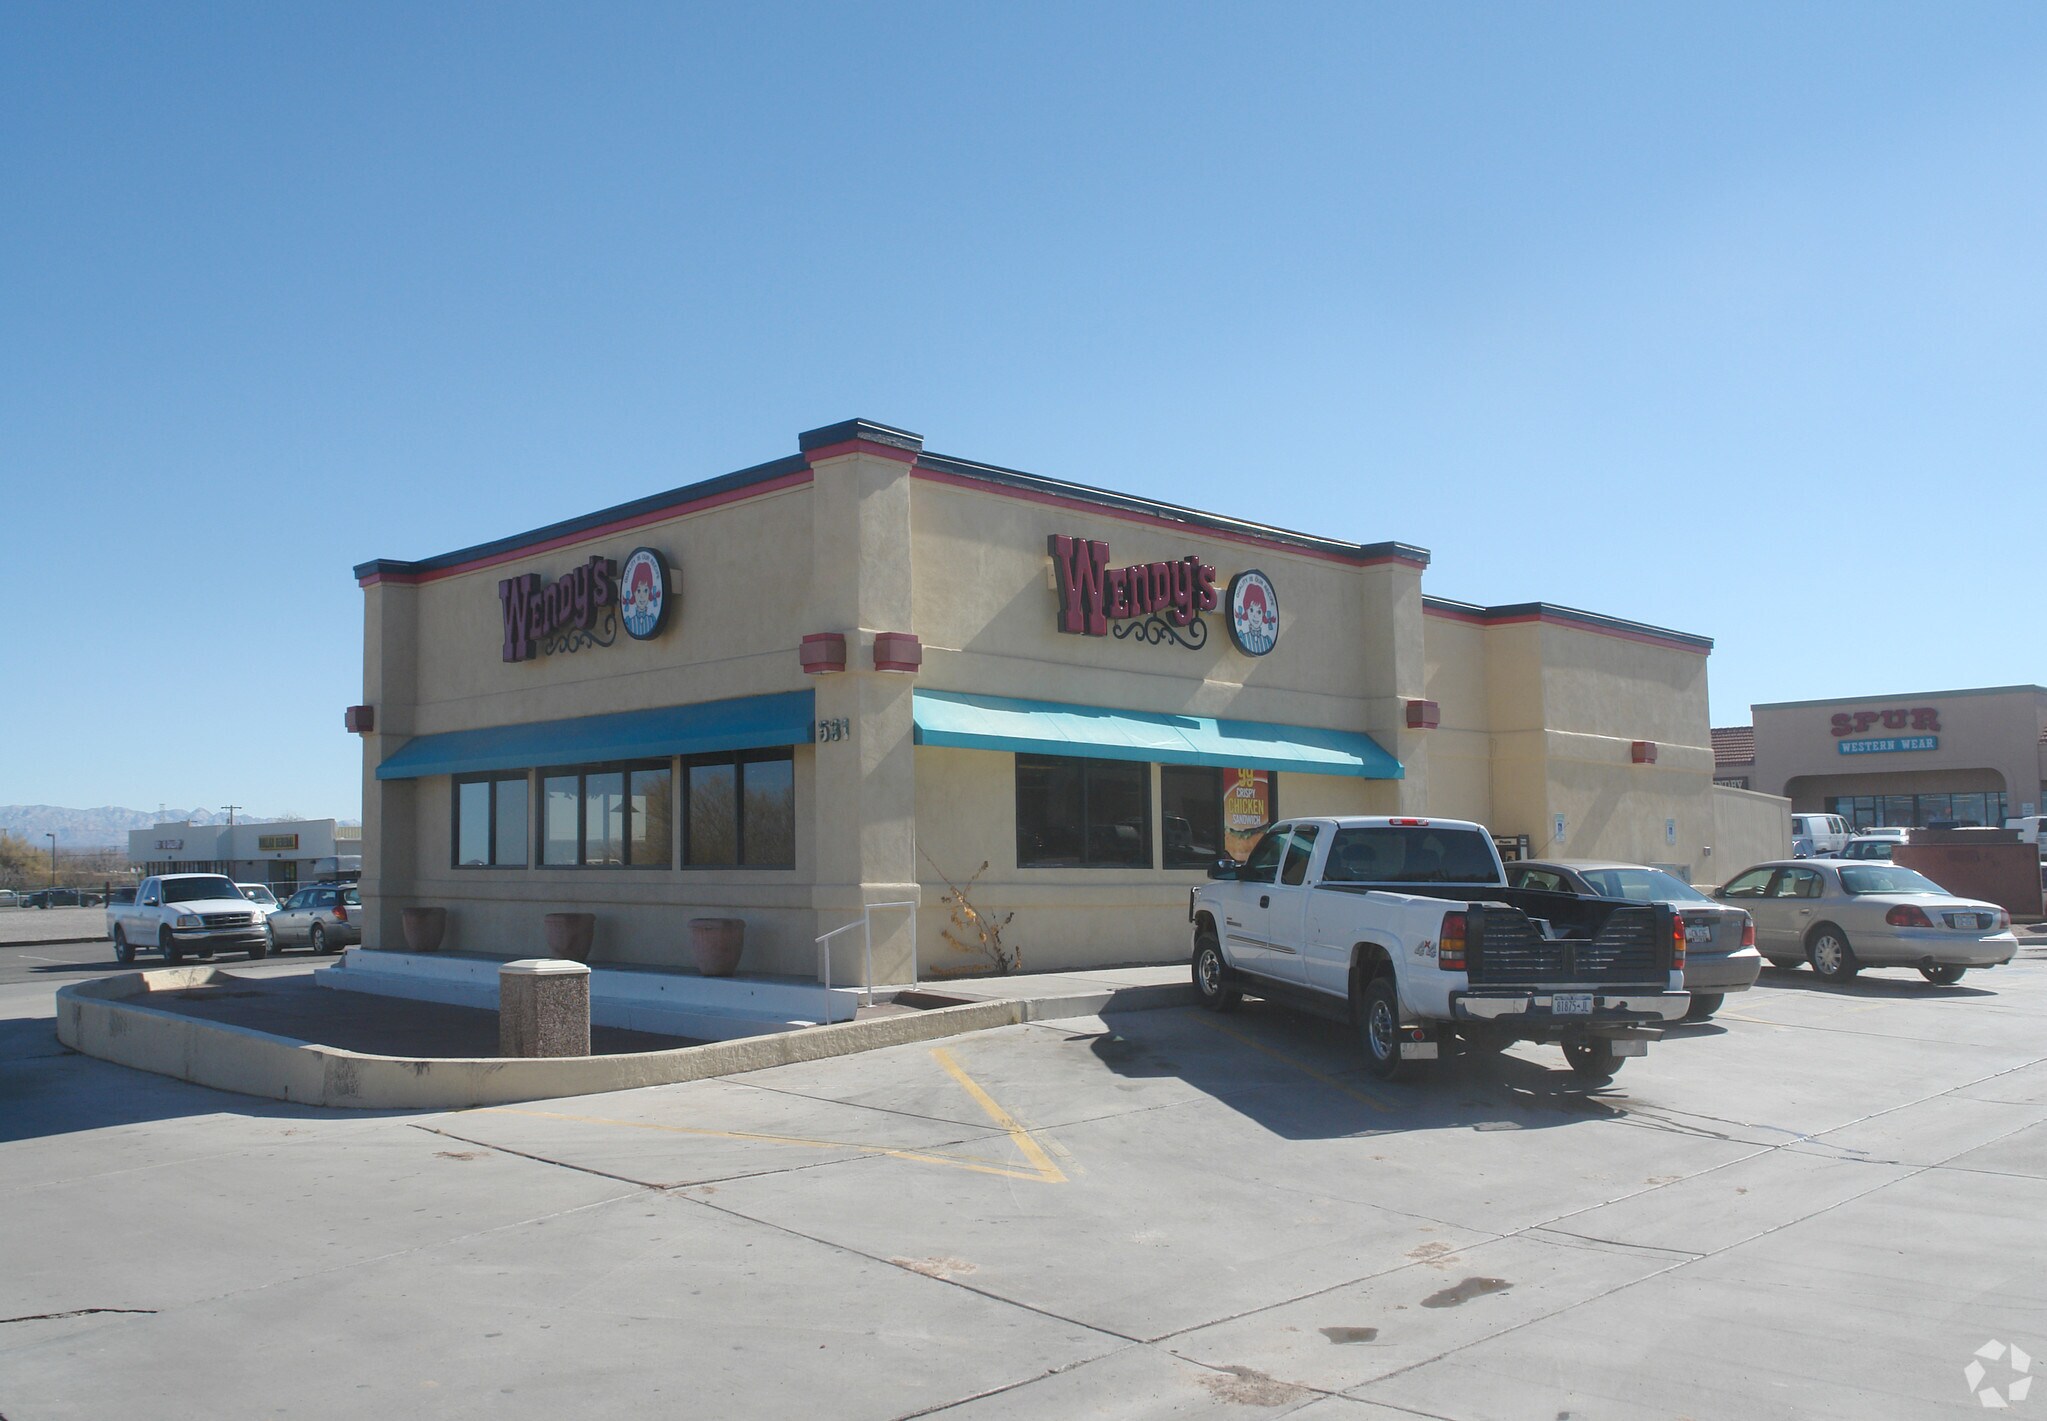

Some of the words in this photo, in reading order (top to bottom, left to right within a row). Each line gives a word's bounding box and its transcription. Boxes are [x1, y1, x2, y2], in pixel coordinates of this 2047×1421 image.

[1831, 707, 1942, 737] SPUR
[1842, 740, 1895, 753] WESTERN
[1901, 737, 1935, 750] WEAR
[1236, 787, 1256, 798] CRISPY
[1228, 798, 1265, 815] CHICKEN
[1232, 814, 1261, 825] SANDWICH
